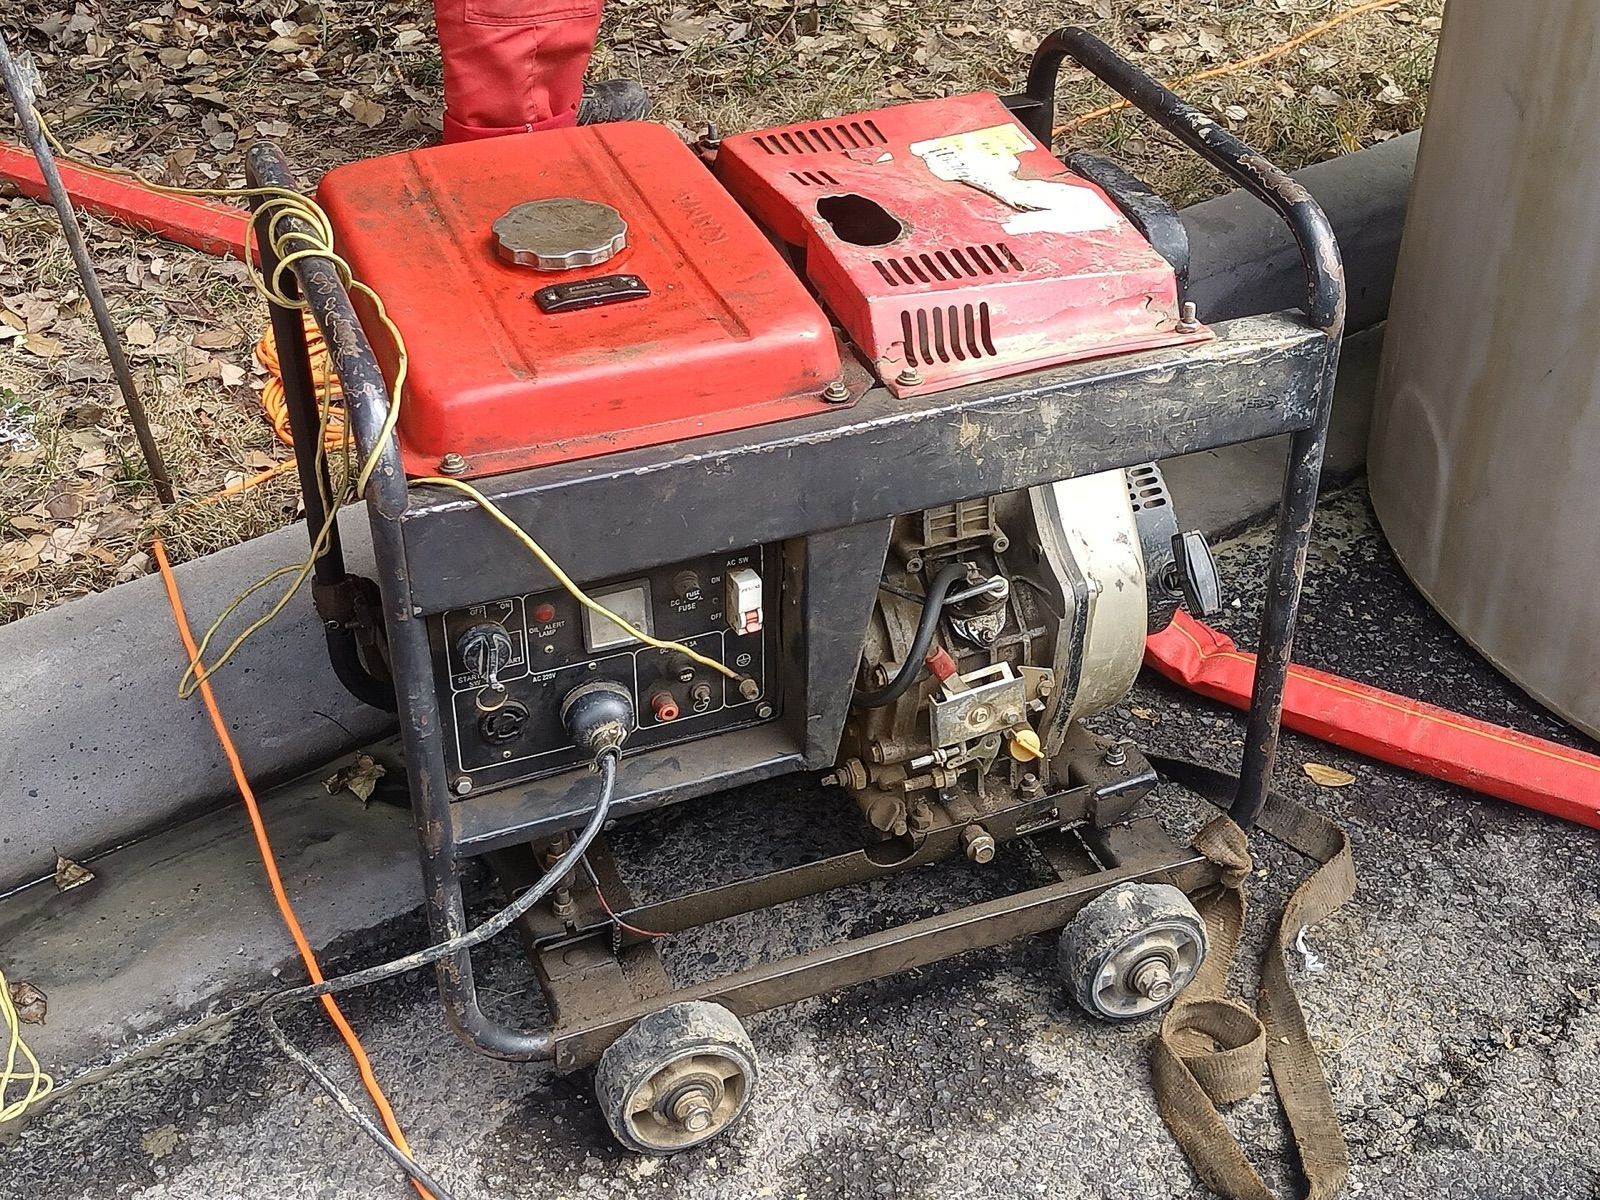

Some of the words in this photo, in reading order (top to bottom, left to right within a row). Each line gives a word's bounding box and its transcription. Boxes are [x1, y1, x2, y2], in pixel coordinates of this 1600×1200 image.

[726, 559, 736, 567] AC
[711, 576, 721, 584] ON
[678, 602, 696, 612] FUSE
[469, 608, 483, 616] OFF
[710, 612, 722, 620] OFF
[544, 620, 565, 630] ALERT
[538, 629, 557, 638] LAMP
[532, 675, 542, 683] AC
